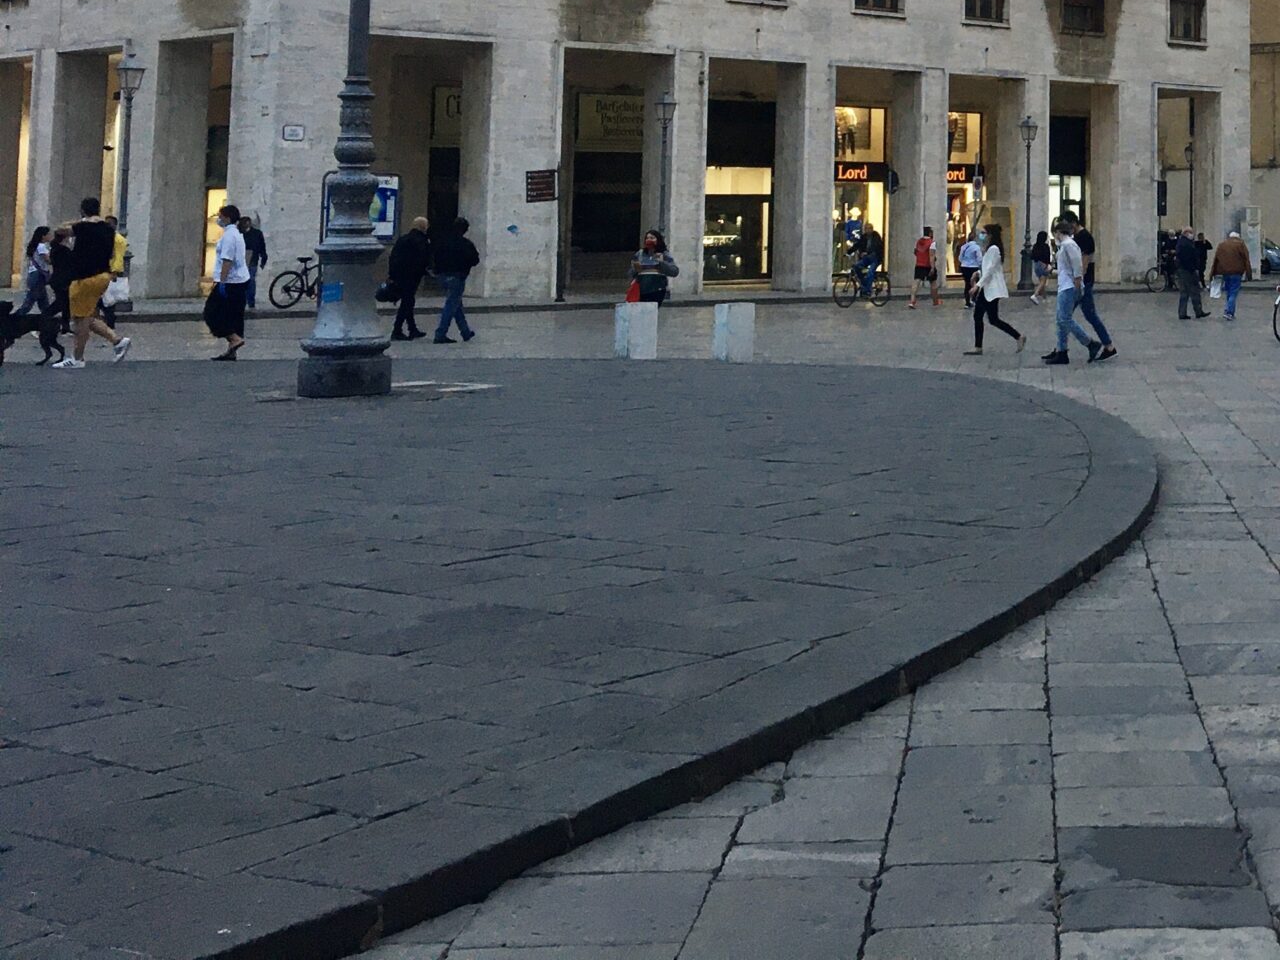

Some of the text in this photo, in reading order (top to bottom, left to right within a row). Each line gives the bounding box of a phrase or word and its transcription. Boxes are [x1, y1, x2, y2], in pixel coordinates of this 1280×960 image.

[446, 94, 462, 119] Ci
[837, 164, 867, 179] Lord
[946, 166, 966, 181] ord
